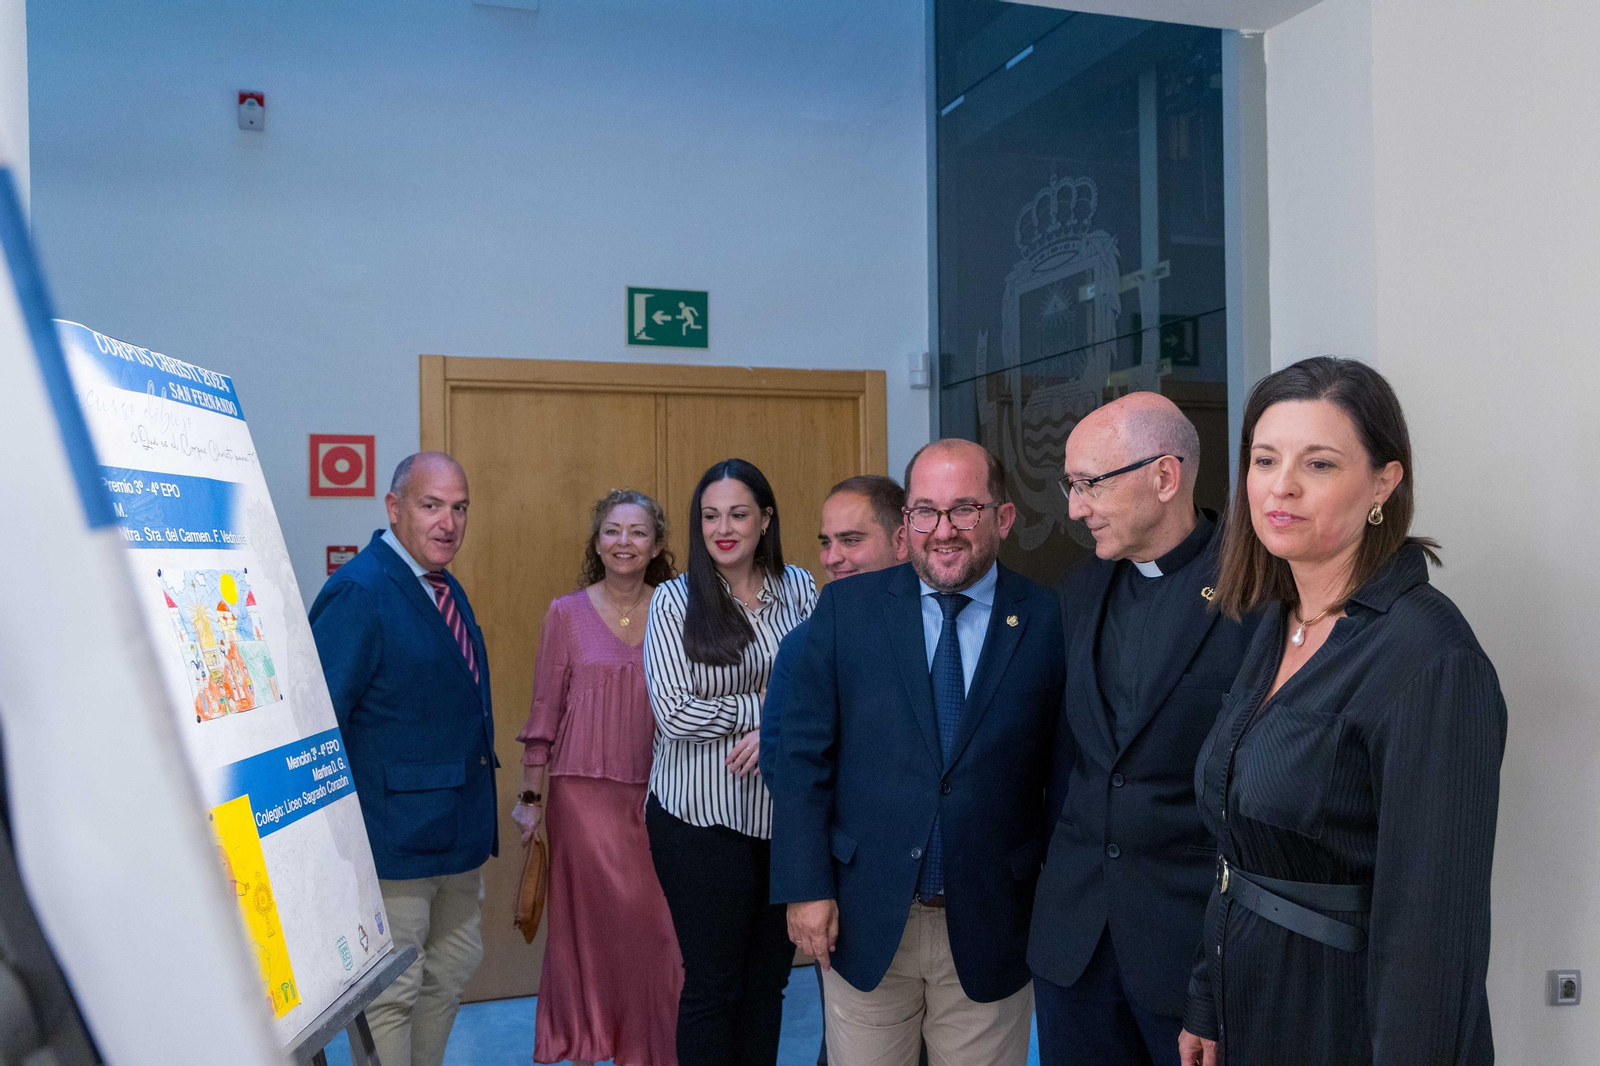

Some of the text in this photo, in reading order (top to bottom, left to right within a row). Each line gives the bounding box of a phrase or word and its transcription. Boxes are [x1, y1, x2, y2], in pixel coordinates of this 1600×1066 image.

[93, 331, 231, 394] CORPUS CHRISTI 2024
[169, 381, 238, 416] SAN FERNANDO
[160, 483, 181, 498] EPO
[119, 527, 144, 542] Ntra.
[144, 526, 164, 542] Sra.
[165, 527, 179, 542] del
[178, 527, 214, 543] Carmen.
[212, 529, 221, 543] F.
[286, 750, 312, 770] Mención
[325, 739, 340, 755] EPO
[312, 757, 347, 781] Martina D. G.
[255, 774, 350, 827] Colegio: Liceo Sagrado Corazón
